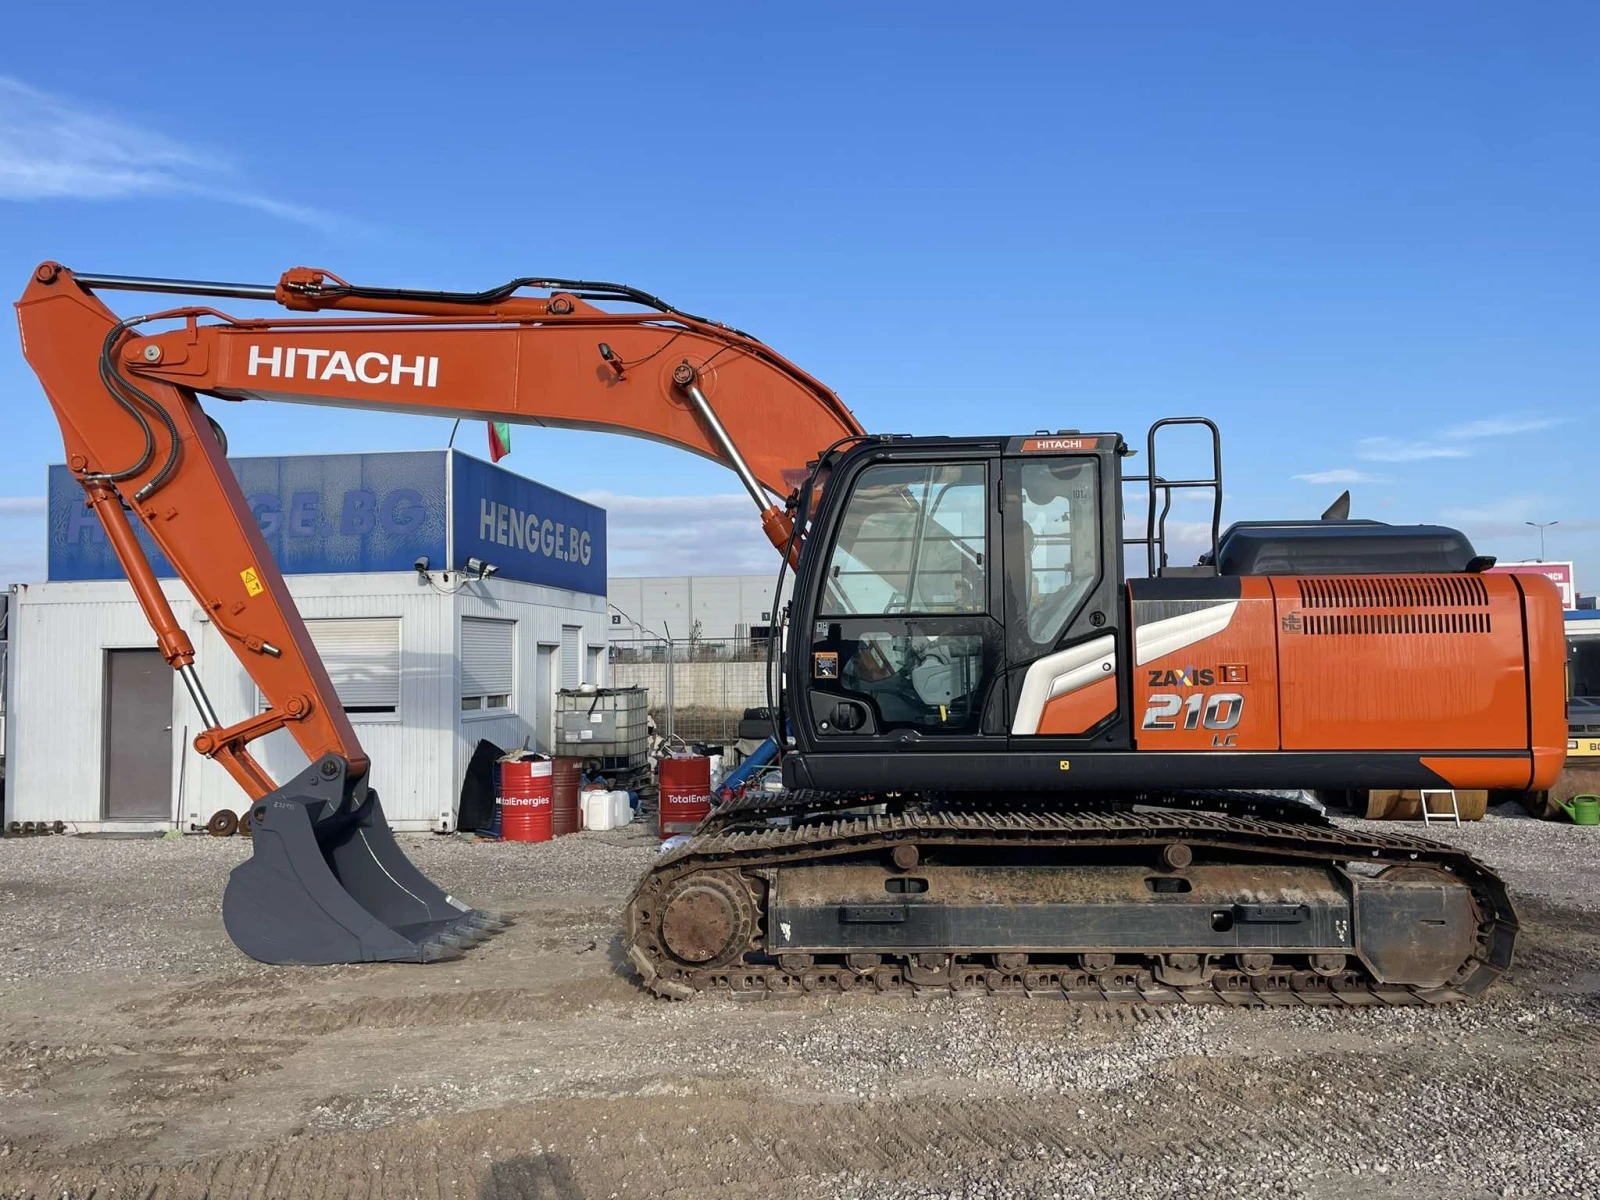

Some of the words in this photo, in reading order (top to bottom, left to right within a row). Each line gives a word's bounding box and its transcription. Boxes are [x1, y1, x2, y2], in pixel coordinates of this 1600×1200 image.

[248, 345, 439, 387] HITACHI
[1037, 440, 1082, 449] HITACHI
[480, 498, 591, 566] HENGGE.BG
[1148, 664, 1215, 687] ZAXIS
[1141, 693, 1245, 731] 210
[1212, 733, 1239, 747] LC
